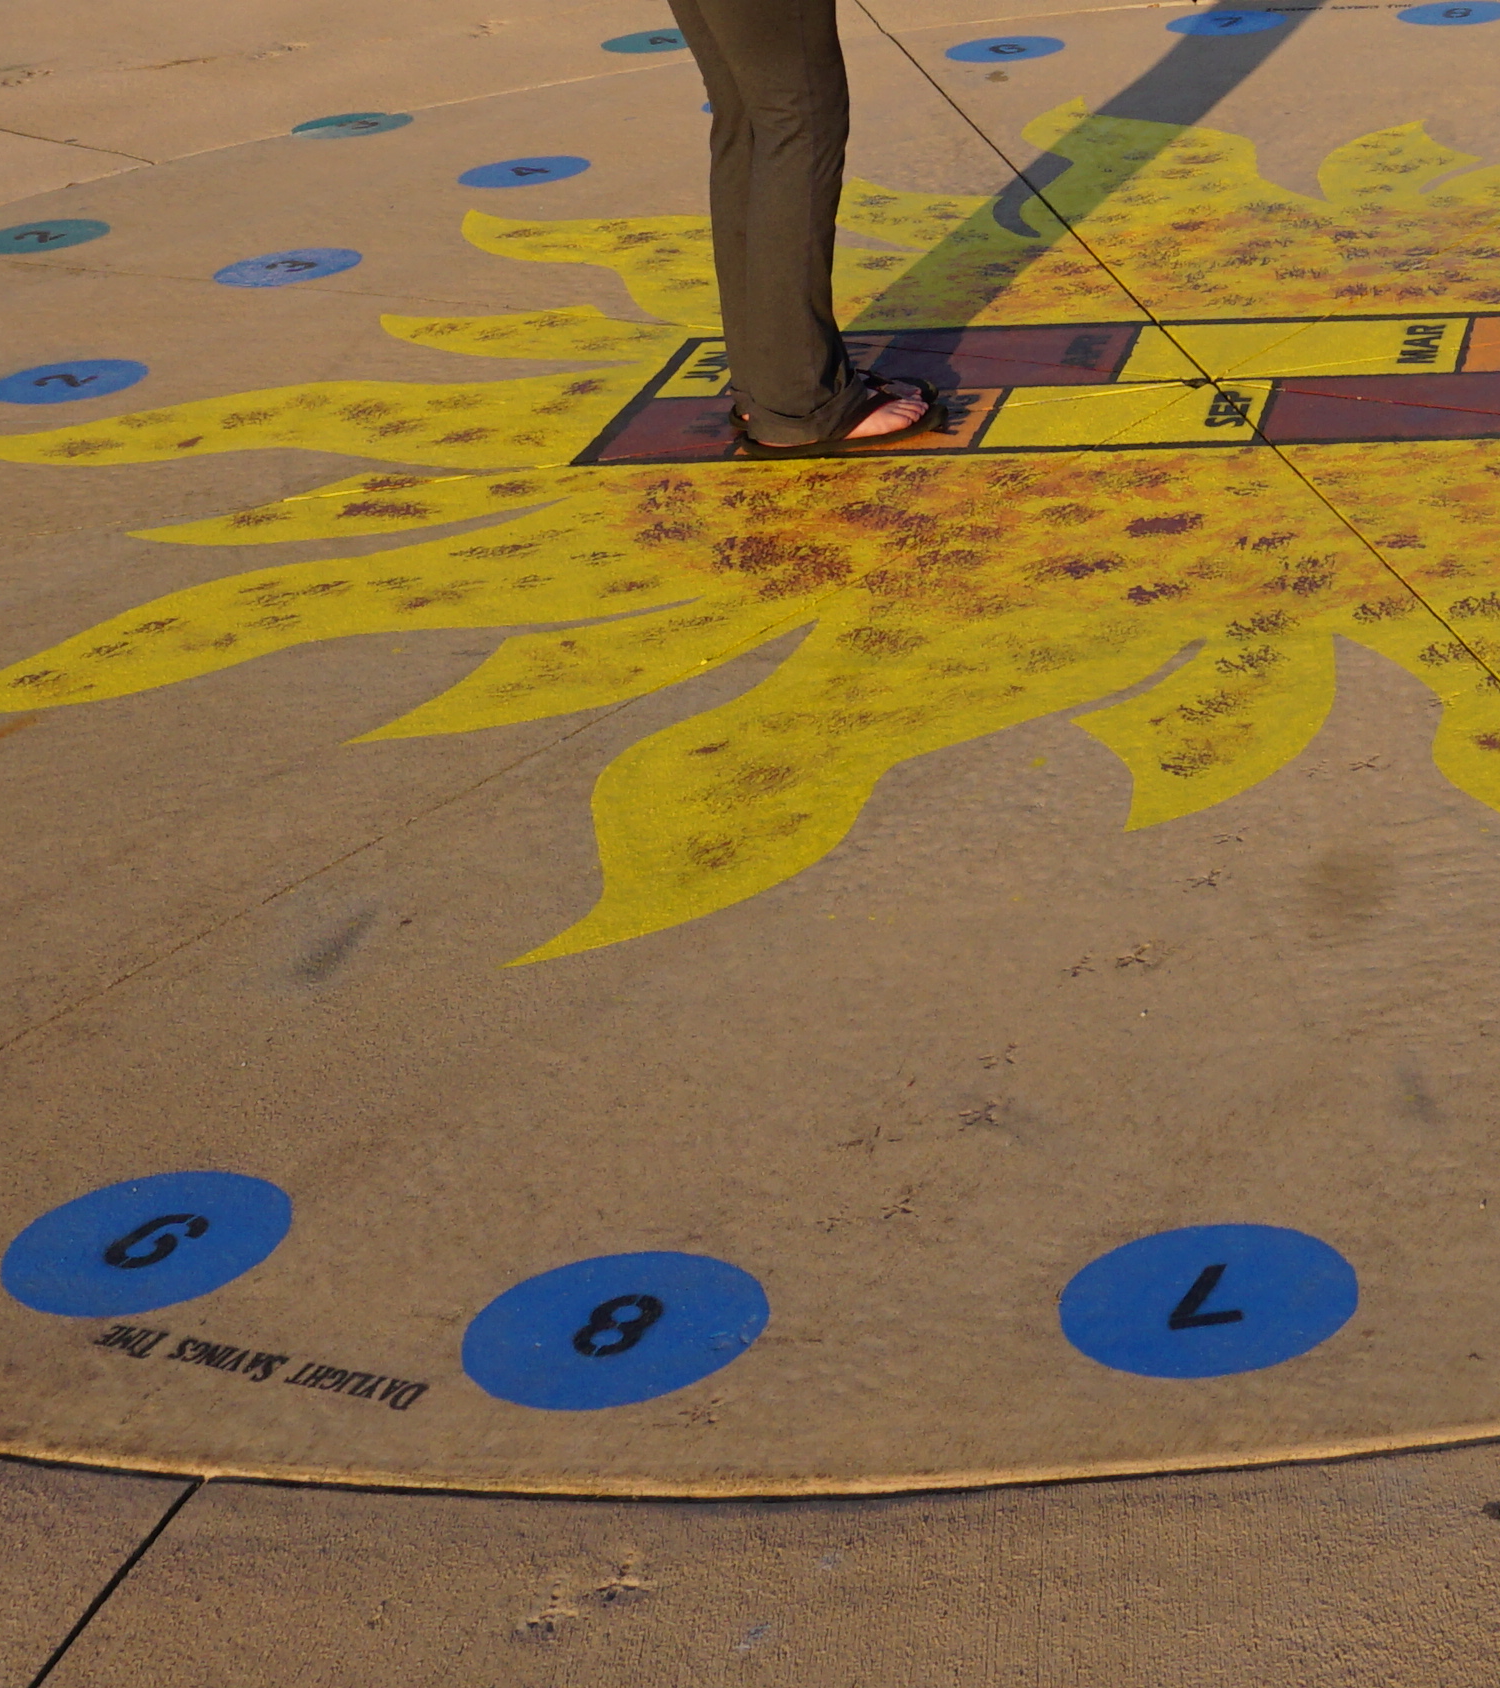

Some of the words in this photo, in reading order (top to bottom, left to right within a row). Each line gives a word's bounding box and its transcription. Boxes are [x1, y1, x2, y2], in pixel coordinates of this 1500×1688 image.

[1211, 16, 1242, 28] 7
[1442, 7, 1473, 18] 8
[649, 36, 677, 45] 4
[510, 166, 550, 176] 4
[14, 230, 67, 243] 2
[265, 260, 317, 271] 3
[1061, 334, 1113, 368] APR
[1396, 323, 1447, 364] MAR
[32, 373, 98, 387] 2
[1204, 390, 1252, 428] SEP
[104, 1213, 209, 1269] 9
[1167, 1263, 1244, 1330] 7
[93, 1324, 170, 1359] TIME
[573, 1293, 664, 1357] 8
[167, 1337, 290, 1383] SAVINGS
[284, 1362, 430, 1411] DAYLIGHT
